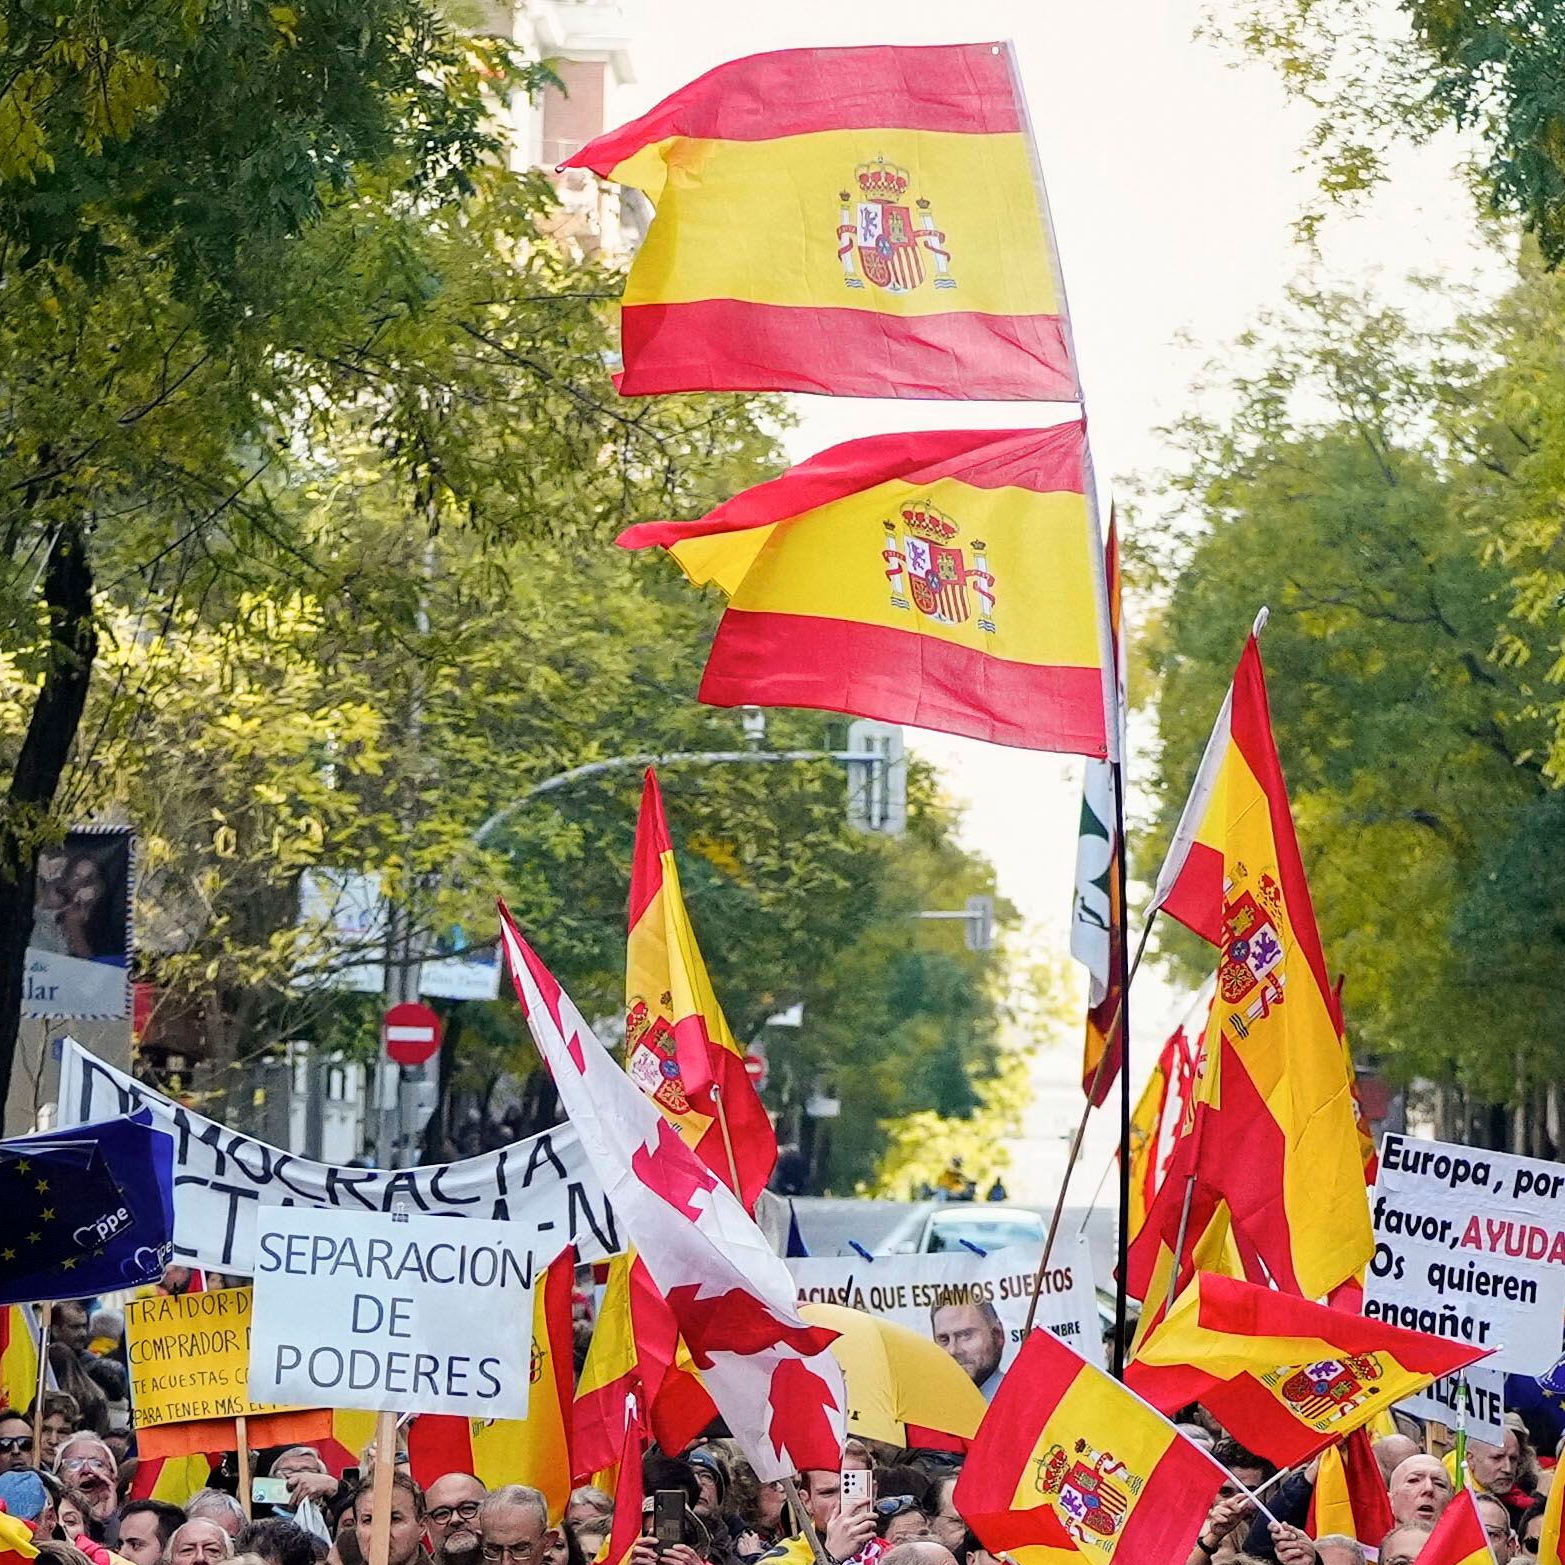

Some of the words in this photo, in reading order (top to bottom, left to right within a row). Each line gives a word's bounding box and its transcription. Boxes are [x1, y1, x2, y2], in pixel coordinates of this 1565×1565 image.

[27, 977, 59, 1000] lar
[1382, 1136, 1503, 1194] Europa,
[1513, 1169, 1565, 1198] por
[96, 1208, 129, 1240] ppe
[260, 1232, 533, 1290] SEPARACIÓN
[1370, 1242, 1405, 1280] Os
[1428, 1260, 1538, 1304] quieren
[797, 1287, 848, 1304] ACIAS
[870, 1286, 905, 1310] QUE
[912, 1281, 995, 1308] ESTAMOS
[352, 1294, 414, 1337] DE
[129, 1329, 240, 1365] COMPRADOR
[151, 1371, 228, 1392] ACUESTAS
[275, 1345, 501, 1398] PODERES
[135, 1407, 162, 1426] PARA
[166, 1402, 210, 1420] TENER
